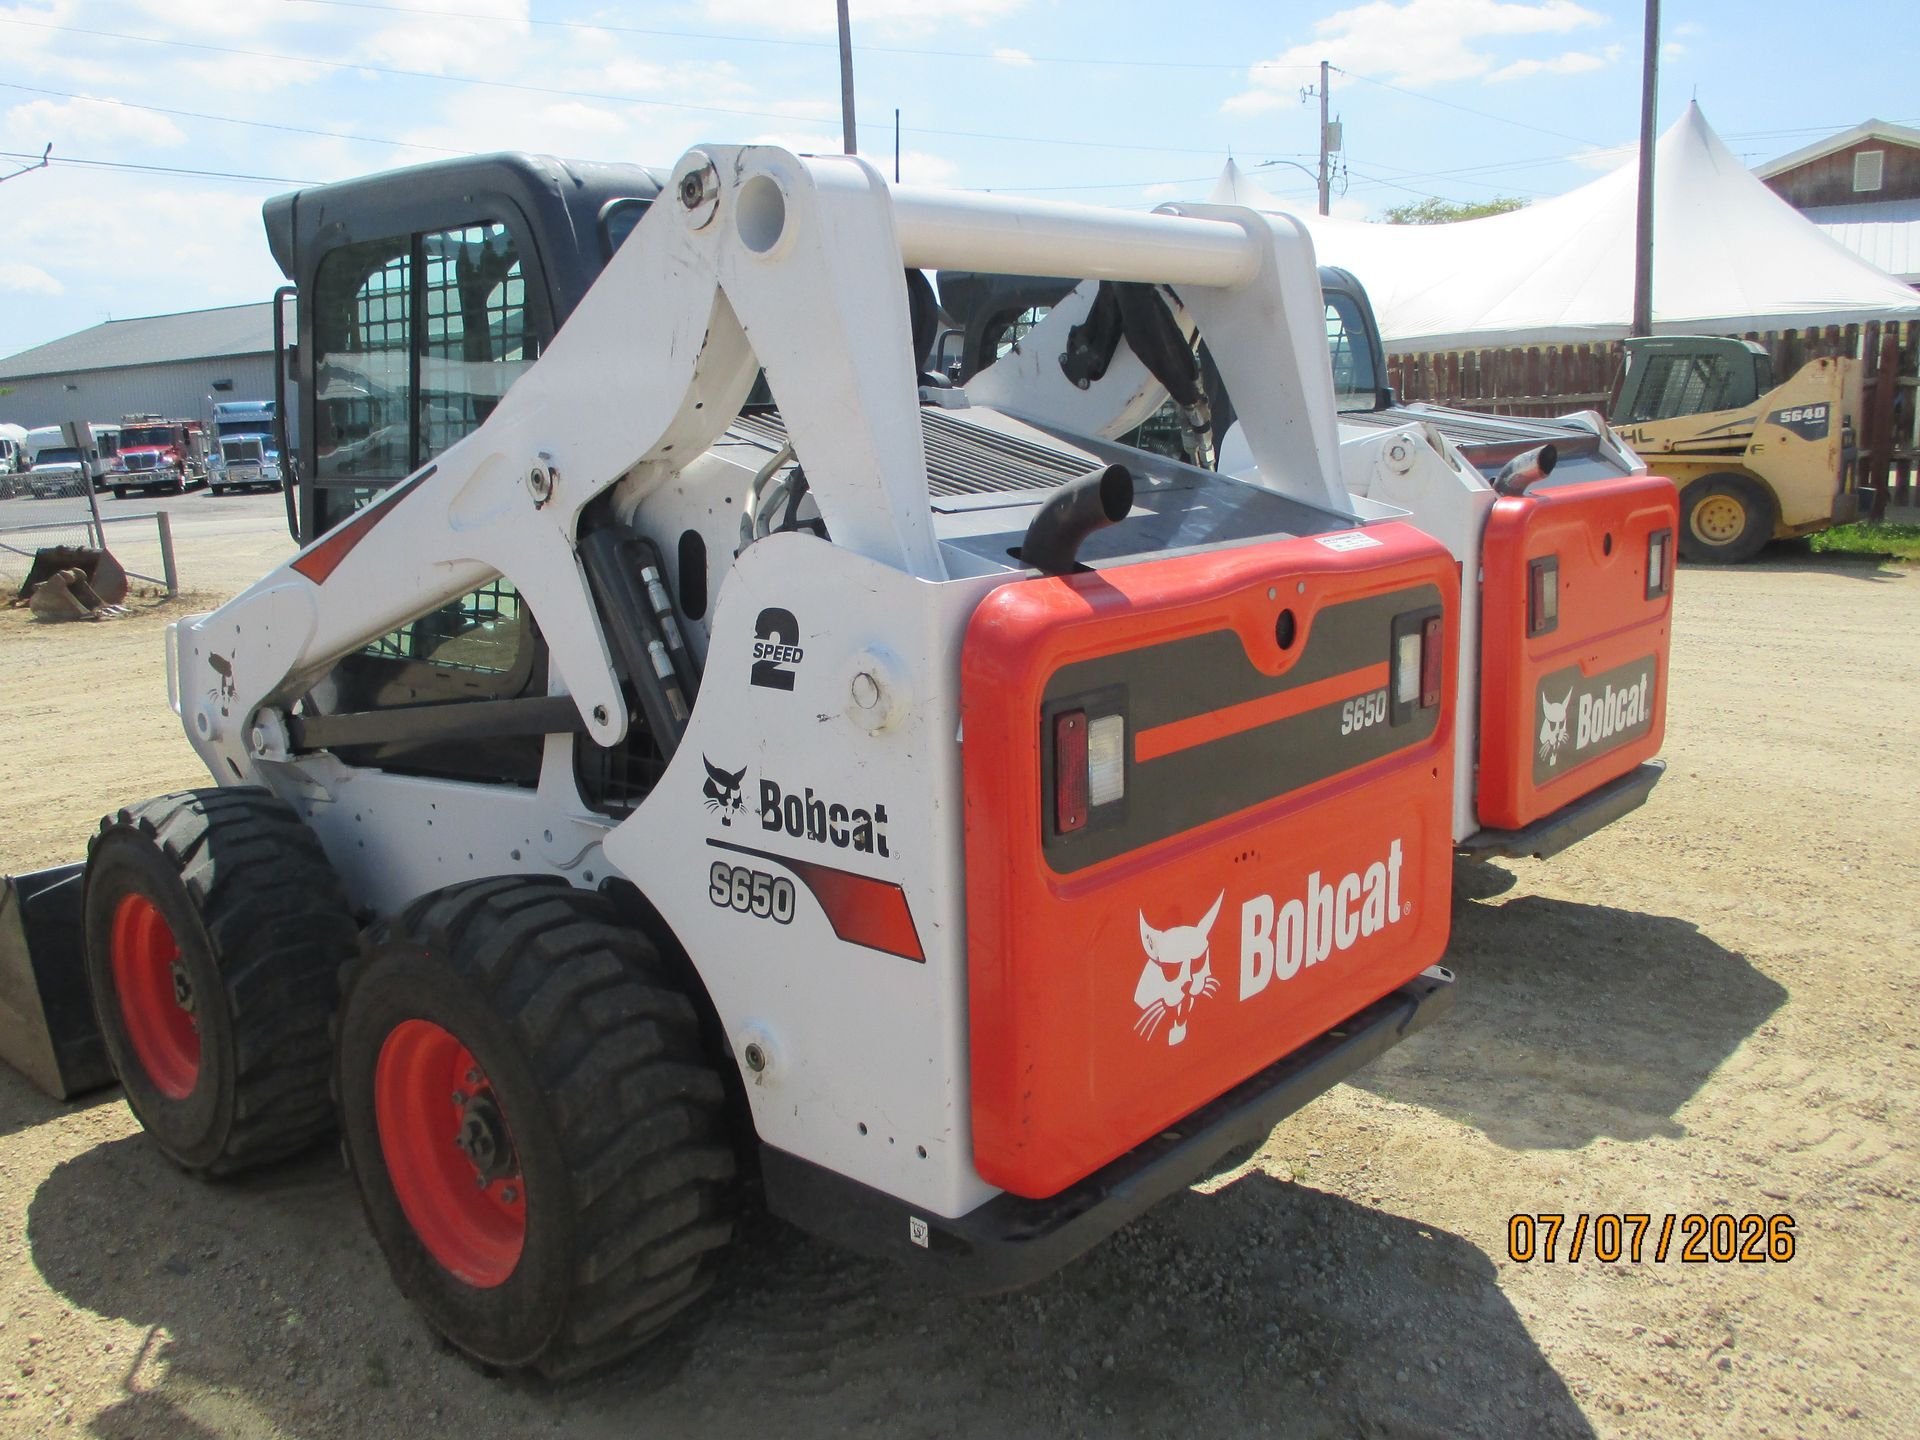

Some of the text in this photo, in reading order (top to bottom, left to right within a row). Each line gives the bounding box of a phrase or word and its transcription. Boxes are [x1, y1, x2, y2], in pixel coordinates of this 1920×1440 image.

[1780, 406, 1827, 423] 5640
[752, 643, 804, 664] SPEED
[1341, 689, 1388, 736] S650
[1576, 672, 1648, 750] Bobcat
[759, 778, 890, 858] Bobcat
[709, 861, 796, 925] S650
[1239, 838, 1403, 1002] Bobcat
